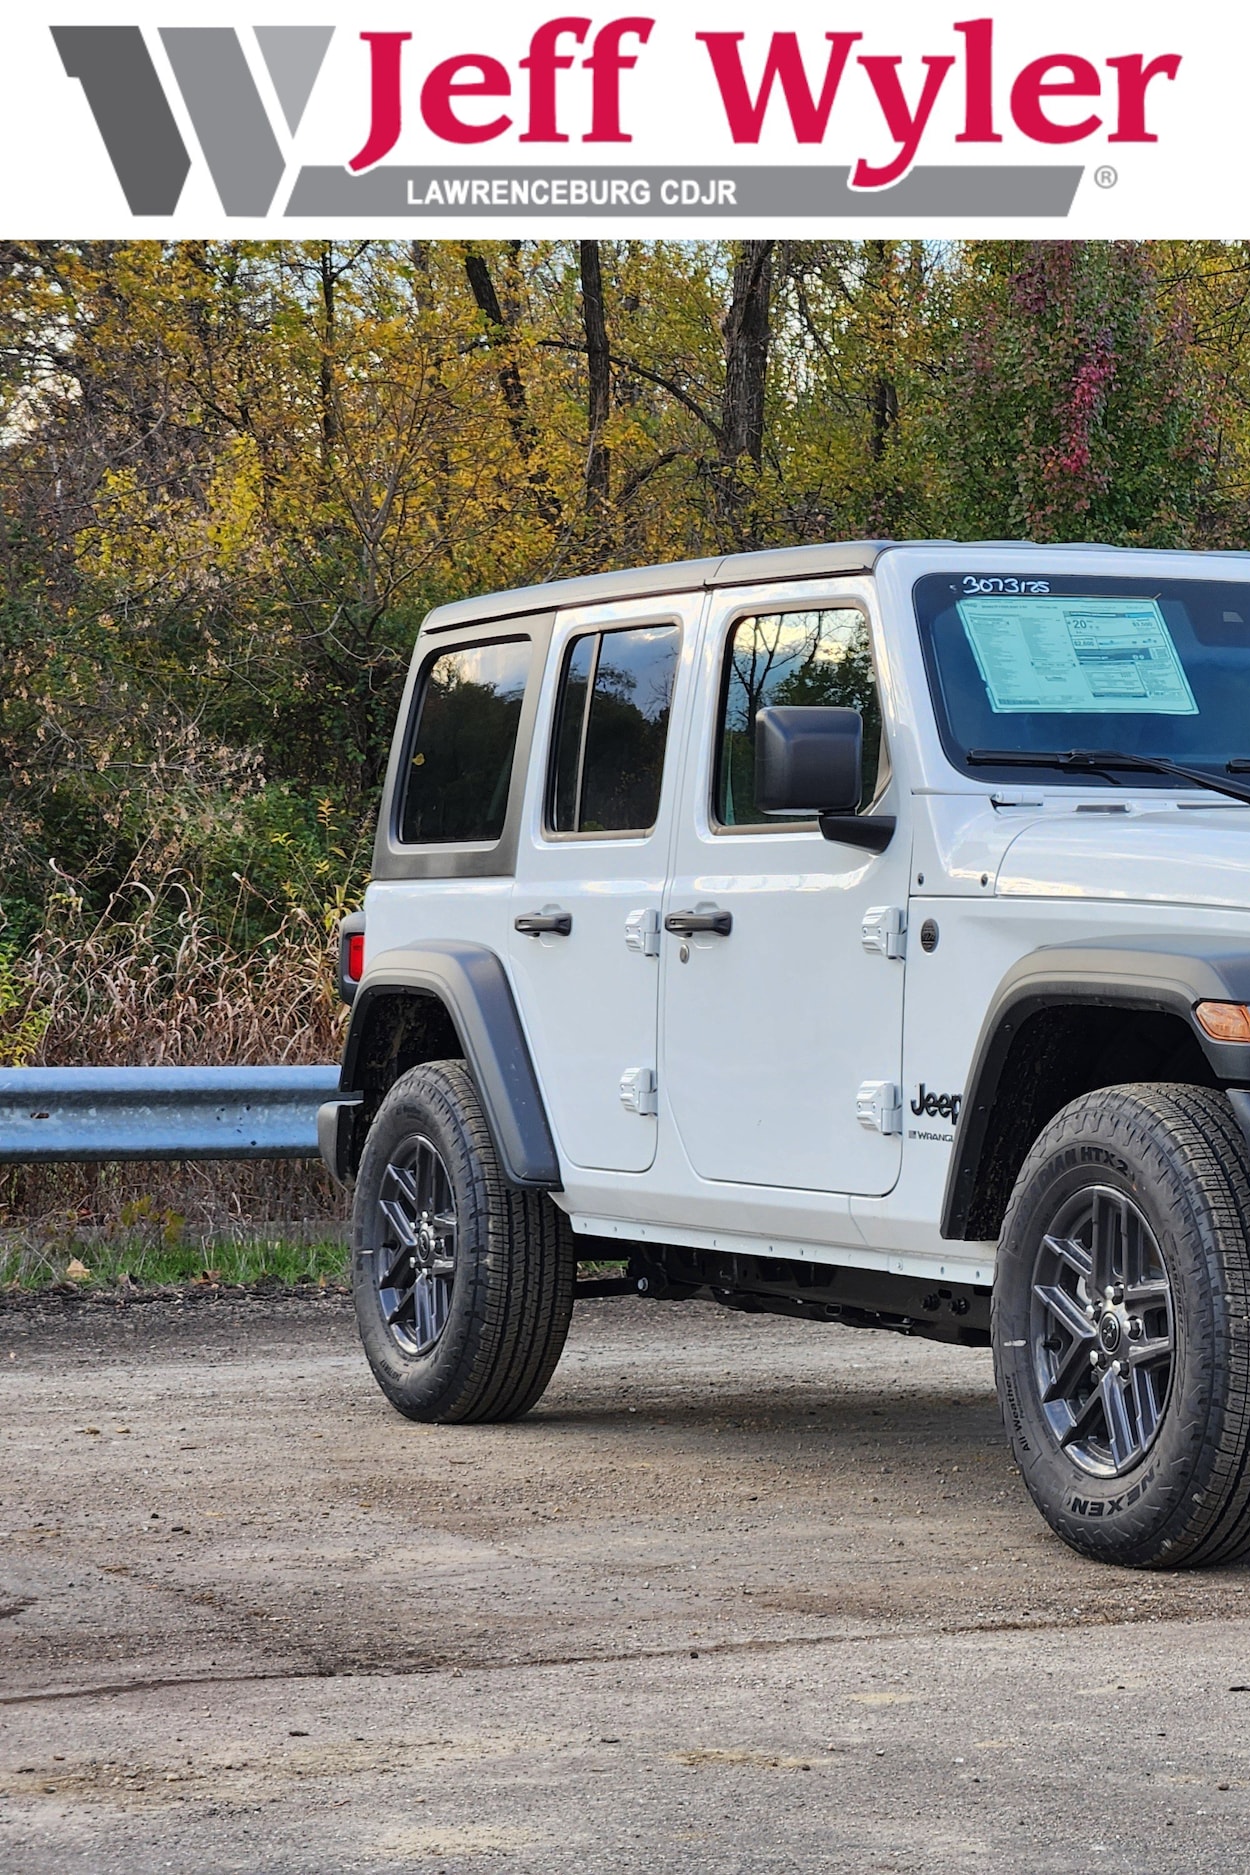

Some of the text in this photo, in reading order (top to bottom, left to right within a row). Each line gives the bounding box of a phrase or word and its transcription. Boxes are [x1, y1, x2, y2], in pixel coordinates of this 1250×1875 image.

[1072, 619, 1087, 629] 20
[910, 1083, 962, 1126] Jeep
[917, 1131, 954, 1142] WRANGL
[1080, 1145, 1129, 1177] HTX2
[1070, 1466, 1156, 1517] NEXEN
